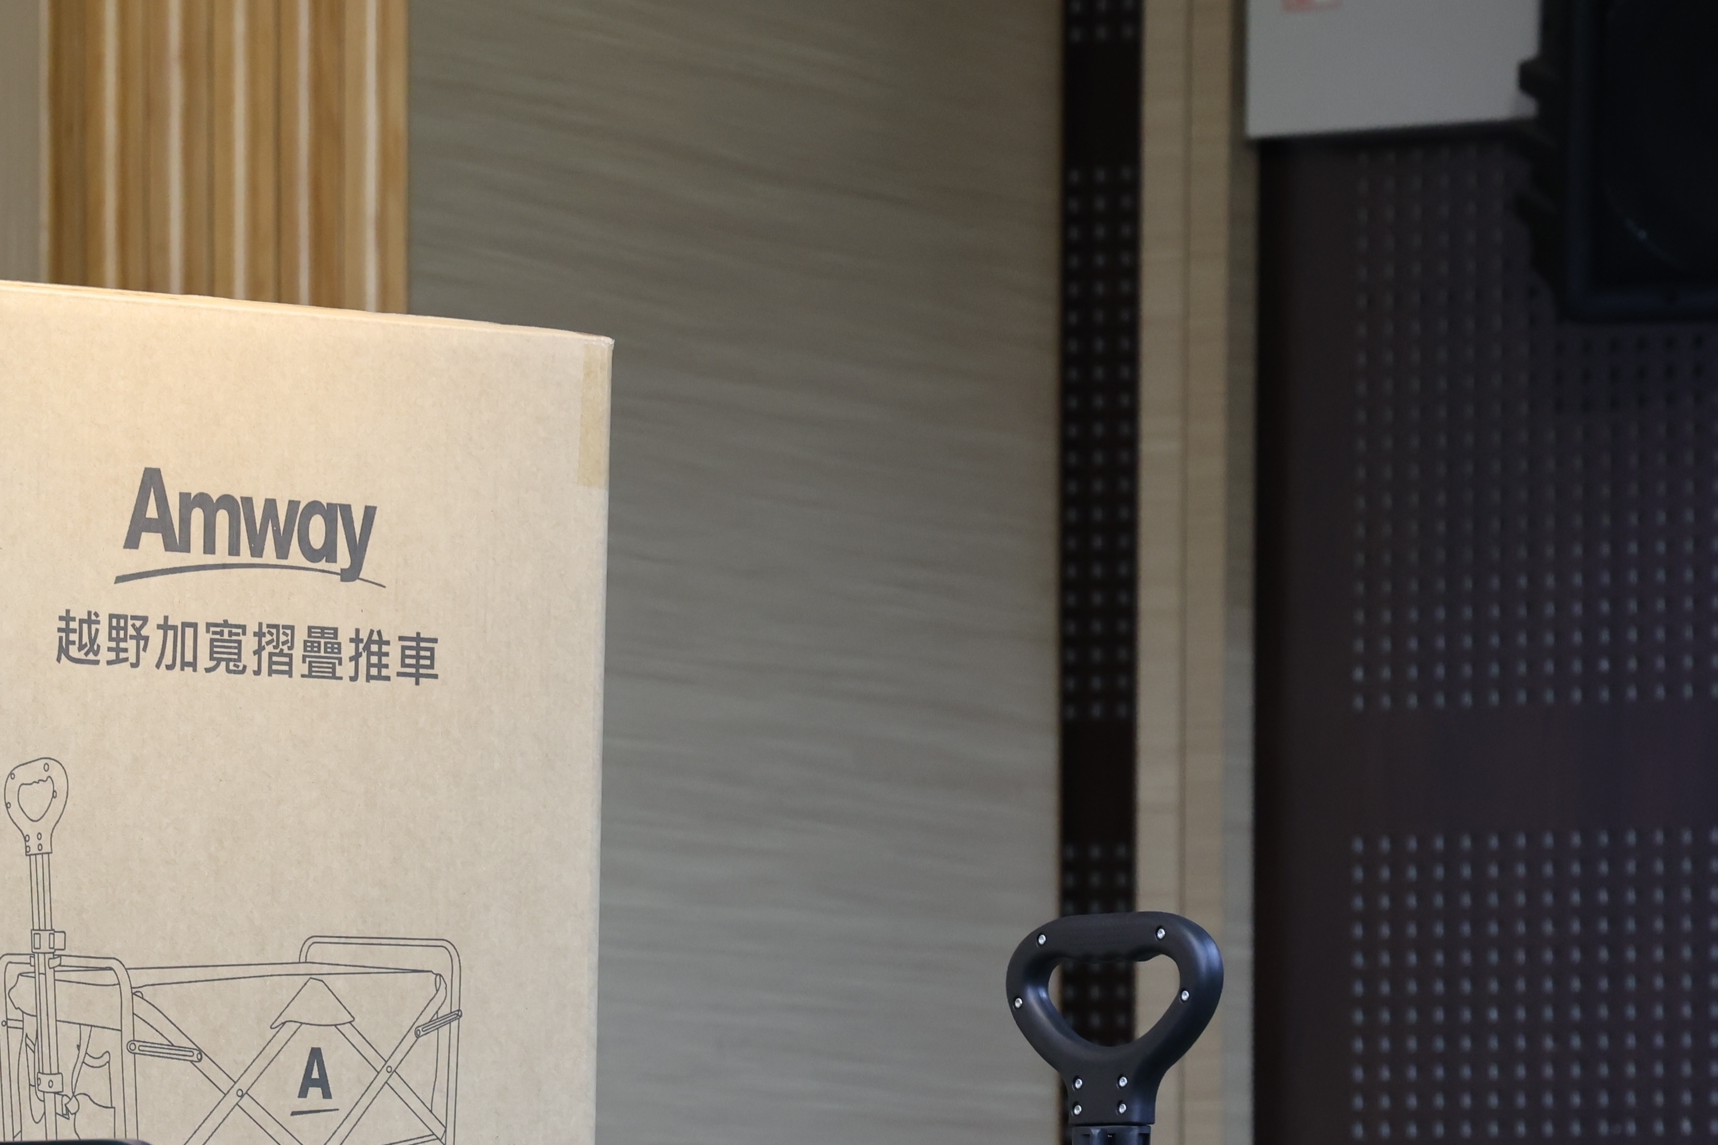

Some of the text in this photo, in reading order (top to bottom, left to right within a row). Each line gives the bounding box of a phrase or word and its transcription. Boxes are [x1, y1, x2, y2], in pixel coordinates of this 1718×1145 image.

[123, 467, 377, 583] Amway
[55, 609, 439, 686] 越野加寬摺疊推車
[298, 1046, 333, 1100] A
